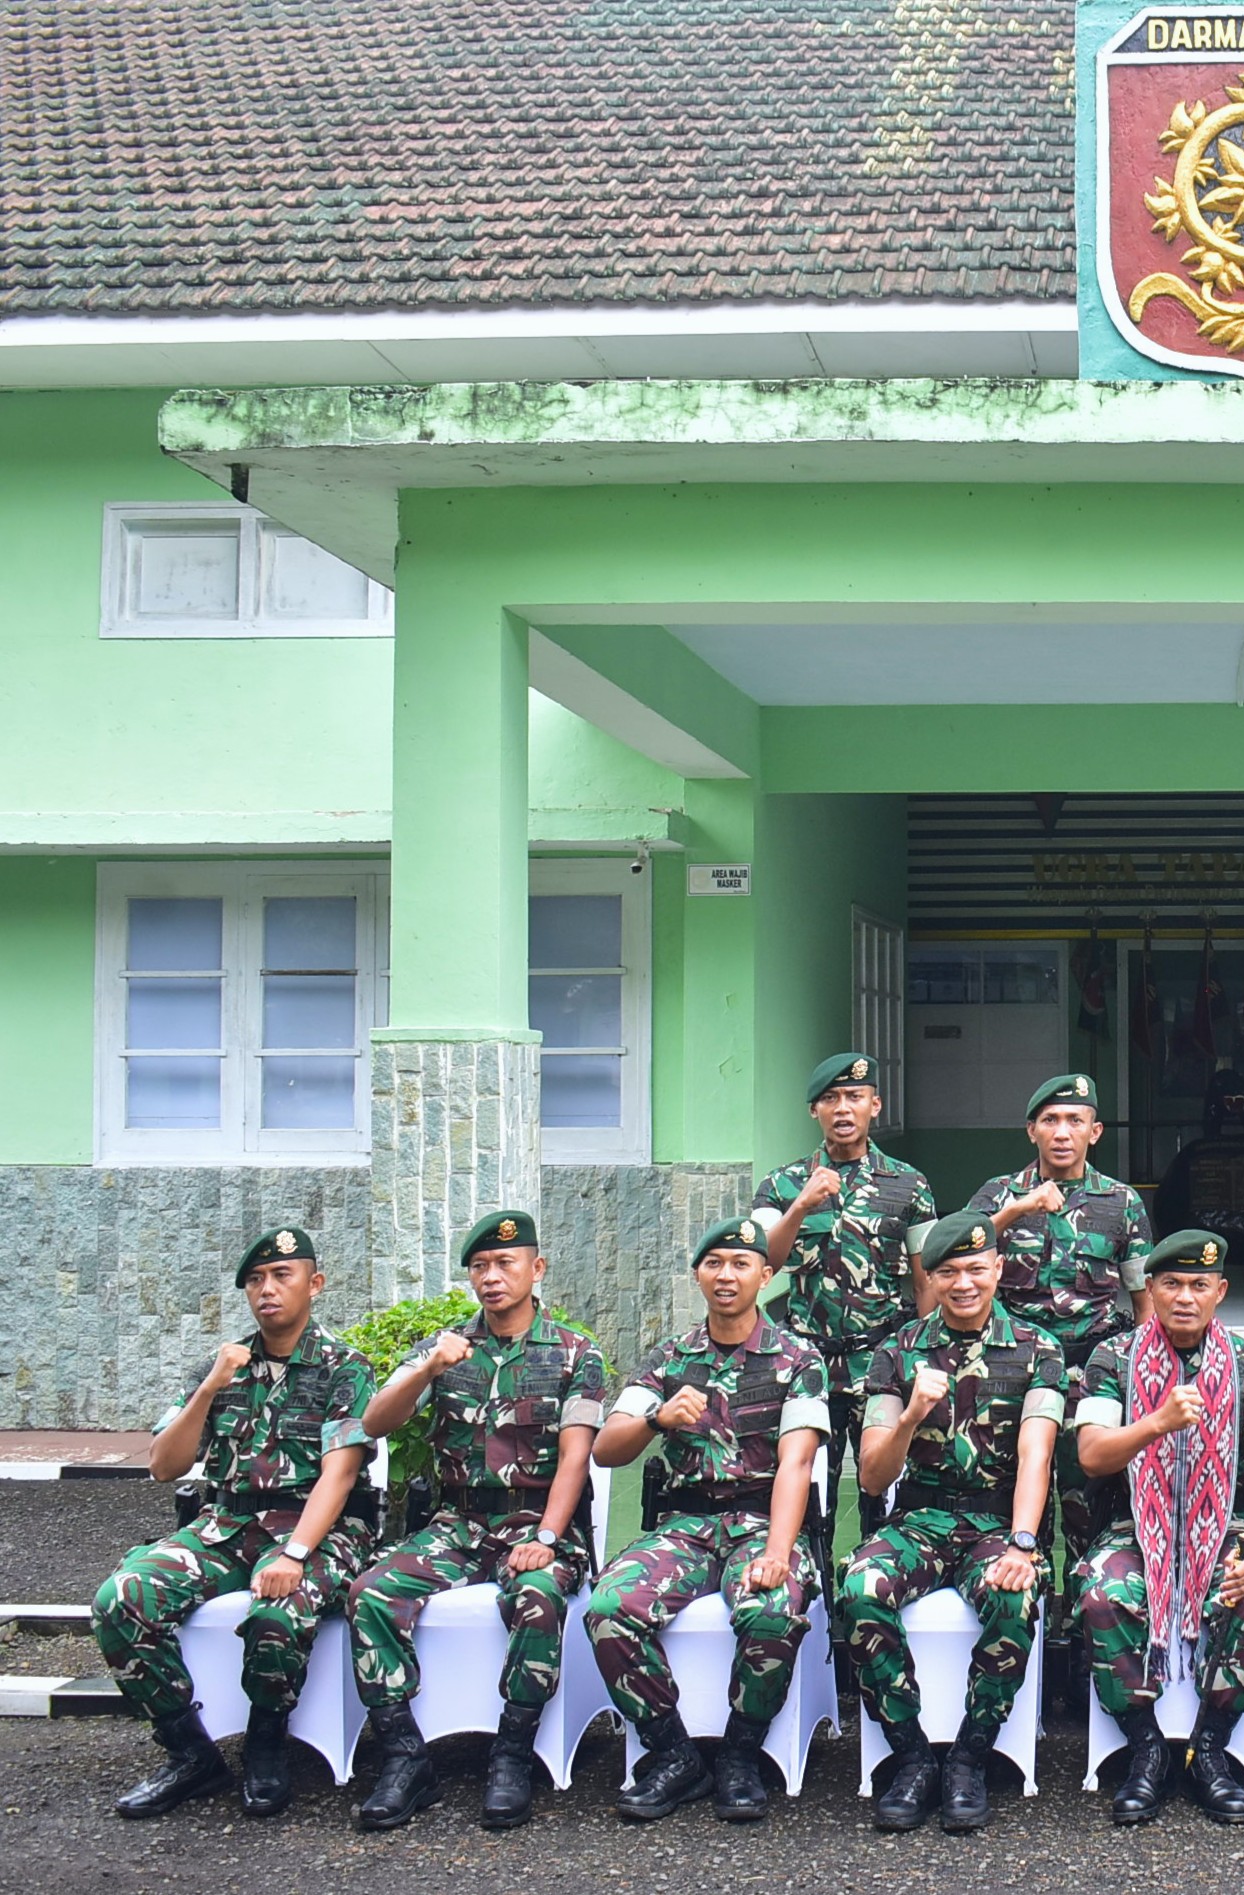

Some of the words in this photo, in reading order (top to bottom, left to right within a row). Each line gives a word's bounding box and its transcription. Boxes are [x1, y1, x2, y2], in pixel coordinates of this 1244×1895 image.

[711, 869, 728, 879] AREA
[728, 869, 748, 879] WAJIB
[1033, 853, 1137, 882] UGRA
[716, 879, 742, 888] MASKER
[985, 1381, 1008, 1394] TNI
[735, 1391, 757, 1404] TNI
